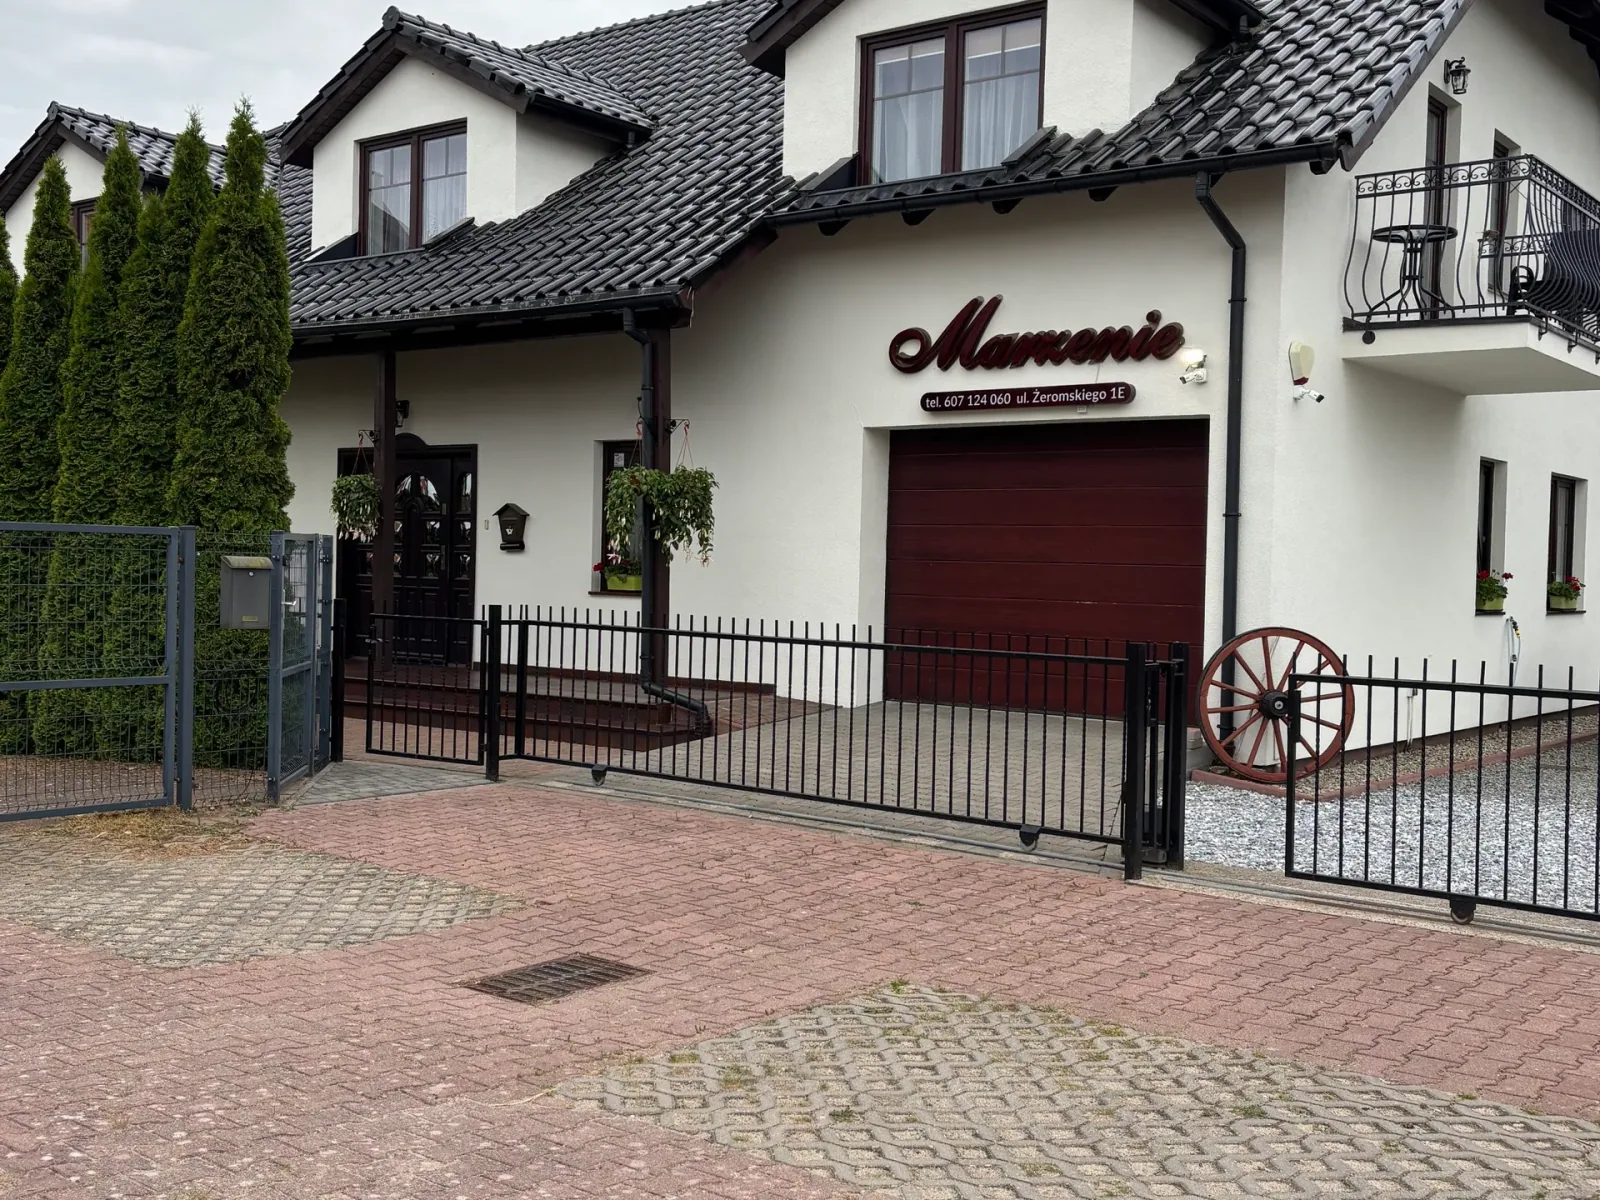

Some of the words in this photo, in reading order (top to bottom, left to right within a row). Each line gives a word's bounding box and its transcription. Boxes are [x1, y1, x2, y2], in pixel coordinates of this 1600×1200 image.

[889, 294, 1184, 374] Marzenie
[926, 396, 942, 408] tel.
[944, 395, 965, 407] 607
[967, 394, 987, 406] 124
[990, 393, 1011, 405] 060
[1016, 392, 1030, 404] ul.
[1032, 389, 1107, 402] Żeromskiego
[1110, 387, 1126, 399] 1E
